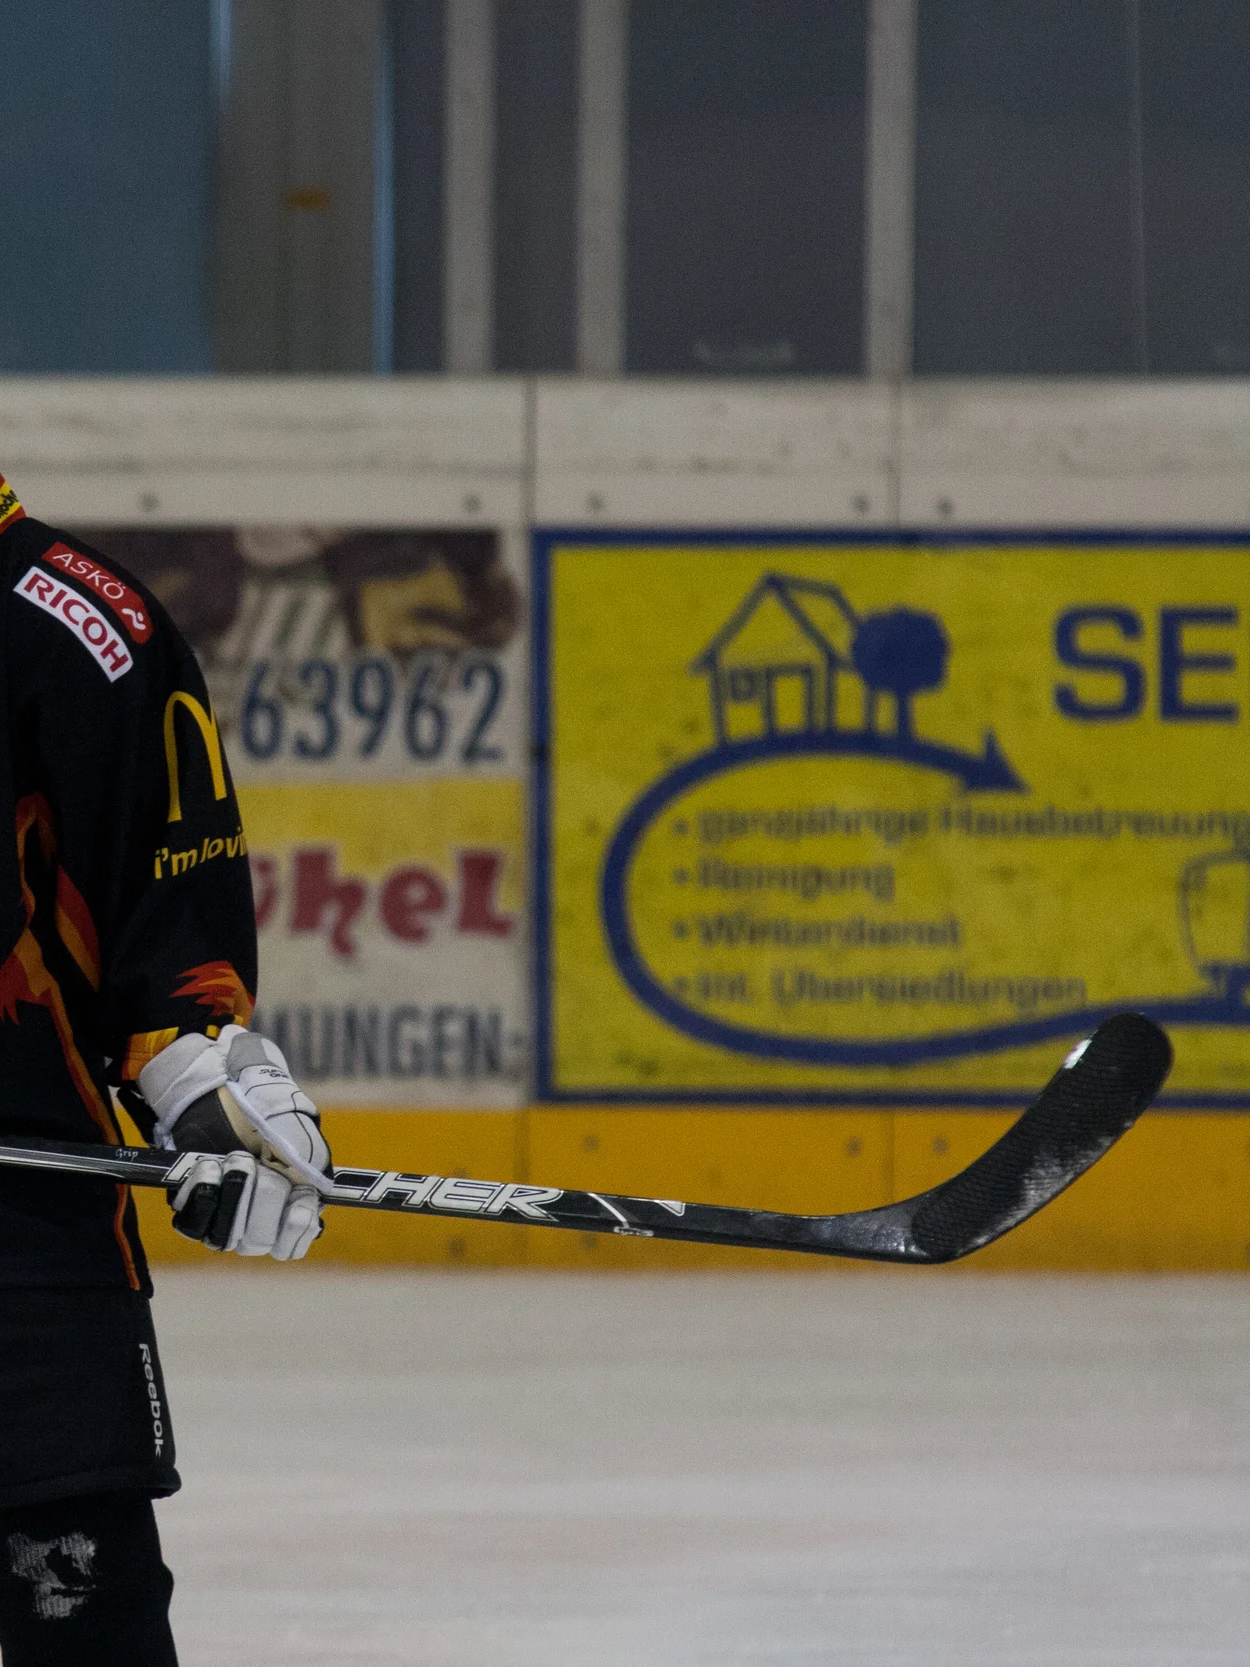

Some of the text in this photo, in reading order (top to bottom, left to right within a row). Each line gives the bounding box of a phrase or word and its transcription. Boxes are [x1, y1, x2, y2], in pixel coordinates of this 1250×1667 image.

[52, 552, 126, 600] ASKÖ
[23, 572, 129, 673] RICOH
[241, 656, 503, 764] 63962
[115, 1149, 139, 1163] Grip
[161, 1152, 564, 1222] FCHER
[138, 1343, 164, 1458] Reebok
